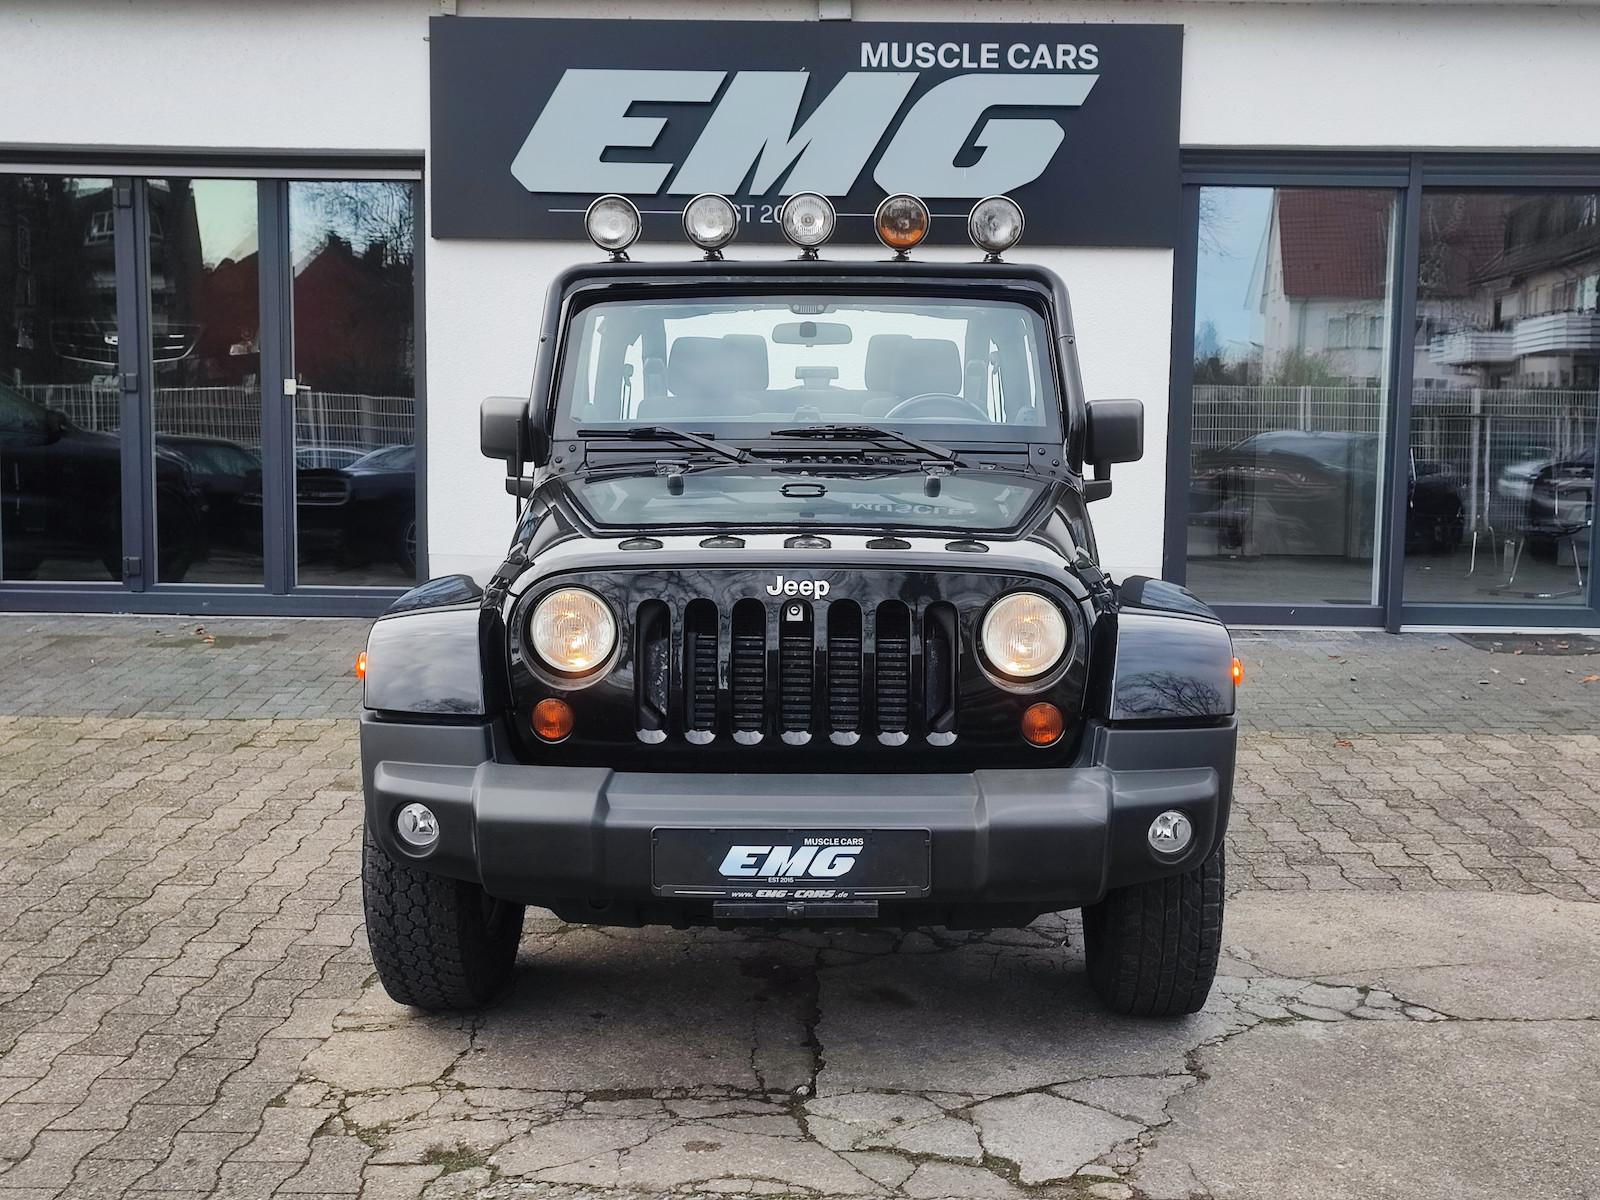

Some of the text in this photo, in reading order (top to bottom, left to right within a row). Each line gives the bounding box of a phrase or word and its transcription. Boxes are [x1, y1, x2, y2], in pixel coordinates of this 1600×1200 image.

[860, 42, 1099, 70] MUSCLE CARS
[510, 68, 1099, 198] EMG
[733, 204, 783, 223] ST 20
[766, 575, 830, 600] Jeep
[803, 838, 864, 846] MUSCLE CARS
[718, 845, 864, 877] EMG
